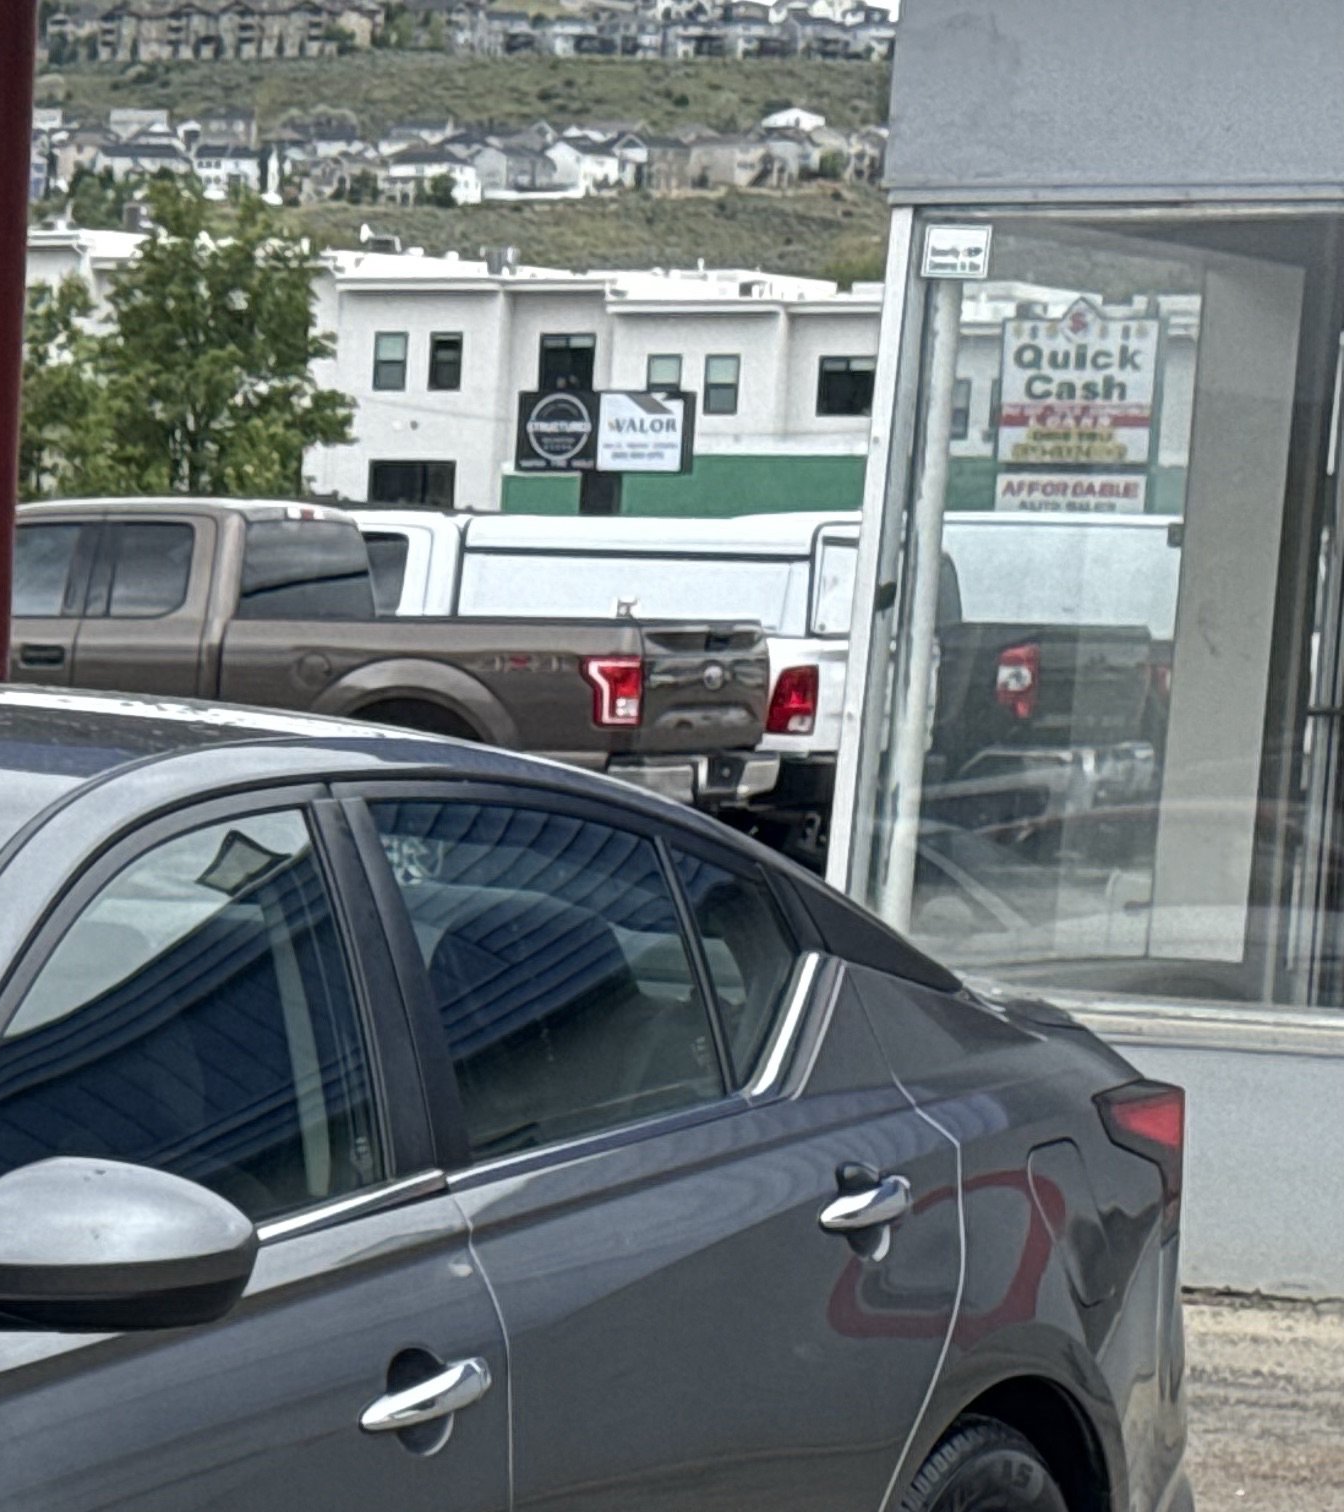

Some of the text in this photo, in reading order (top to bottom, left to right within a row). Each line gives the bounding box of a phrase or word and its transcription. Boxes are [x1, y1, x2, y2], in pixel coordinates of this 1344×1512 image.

[1013, 343, 1143, 371] Quick
[1025, 374, 1127, 400] Cash
[615, 417, 677, 433] VALOR
[1002, 481, 1140, 498] AFFORDABLE
